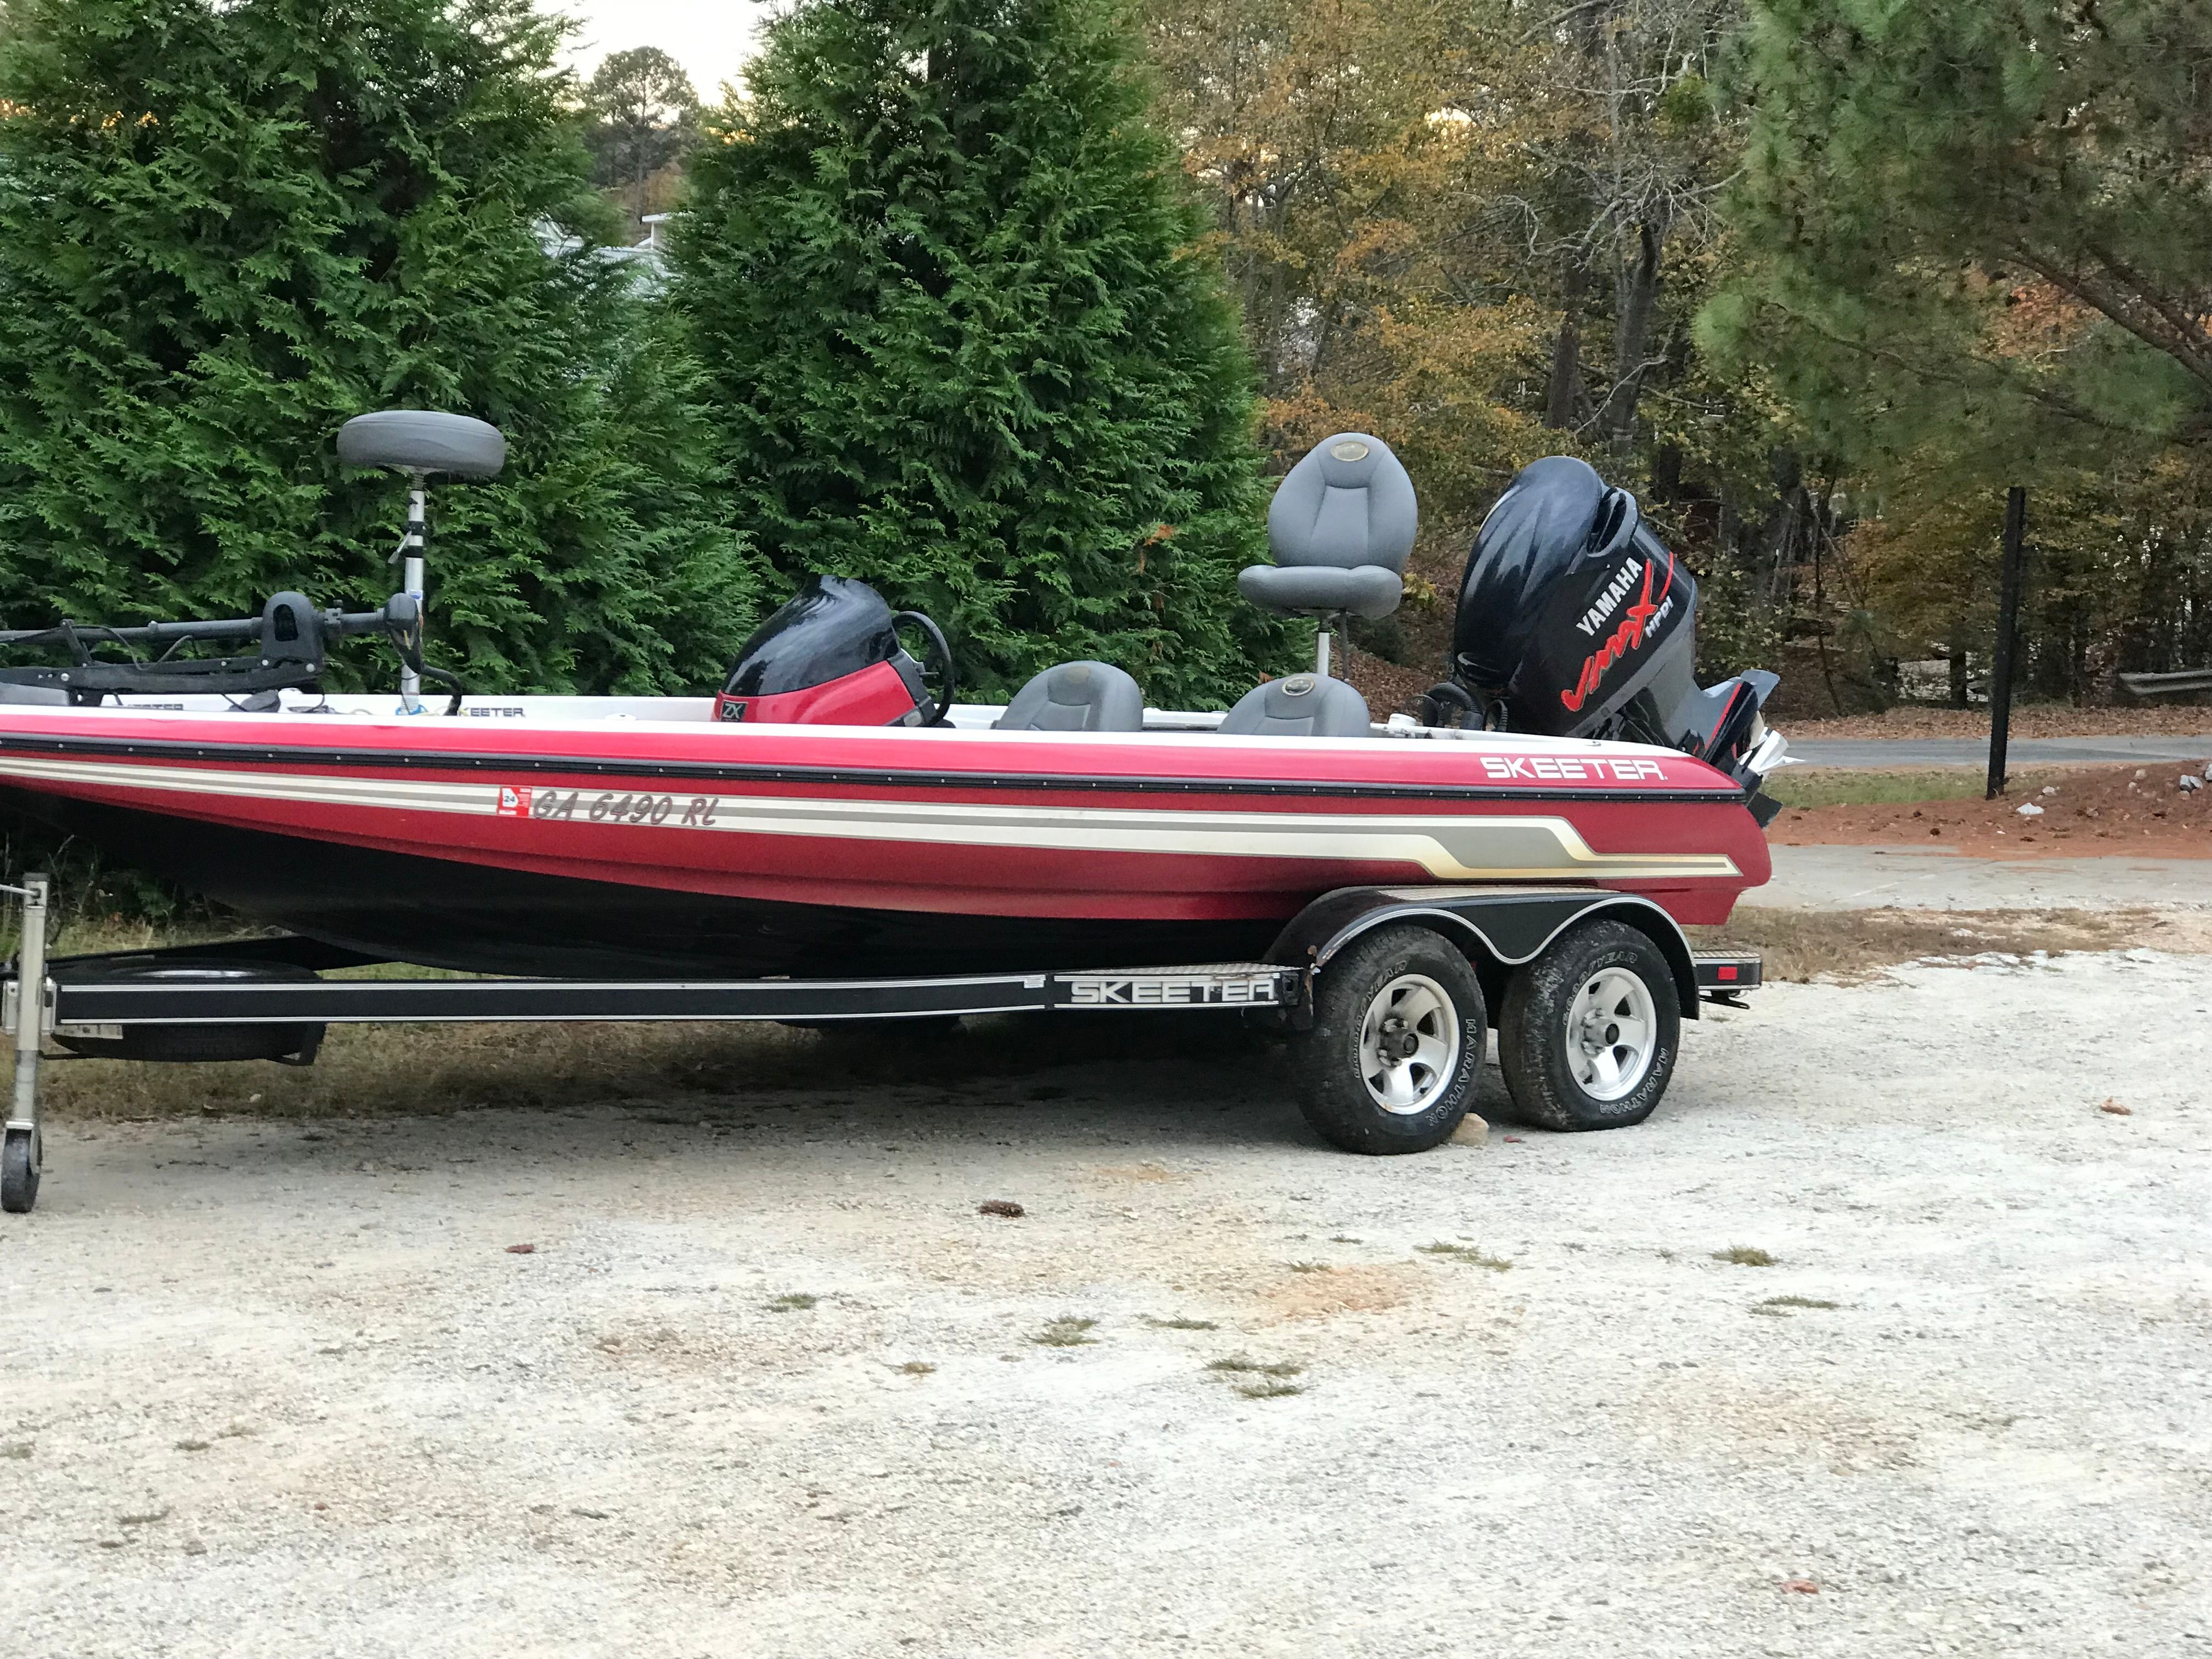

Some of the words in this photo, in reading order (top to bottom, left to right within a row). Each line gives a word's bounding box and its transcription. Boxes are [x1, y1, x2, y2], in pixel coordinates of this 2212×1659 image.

[1576, 557, 1643, 636] YAMAHA
[723, 703, 743, 719] ZX
[1479, 757, 1668, 781] SKEETER
[534, 790, 579, 821] GA
[589, 793, 673, 825] 6490
[681, 797, 719, 826] RL
[1070, 978, 1274, 1003] SKEETER
[1426, 1018, 1477, 1126] MARATHON
[1600, 1047, 1668, 1114] MARATHON
